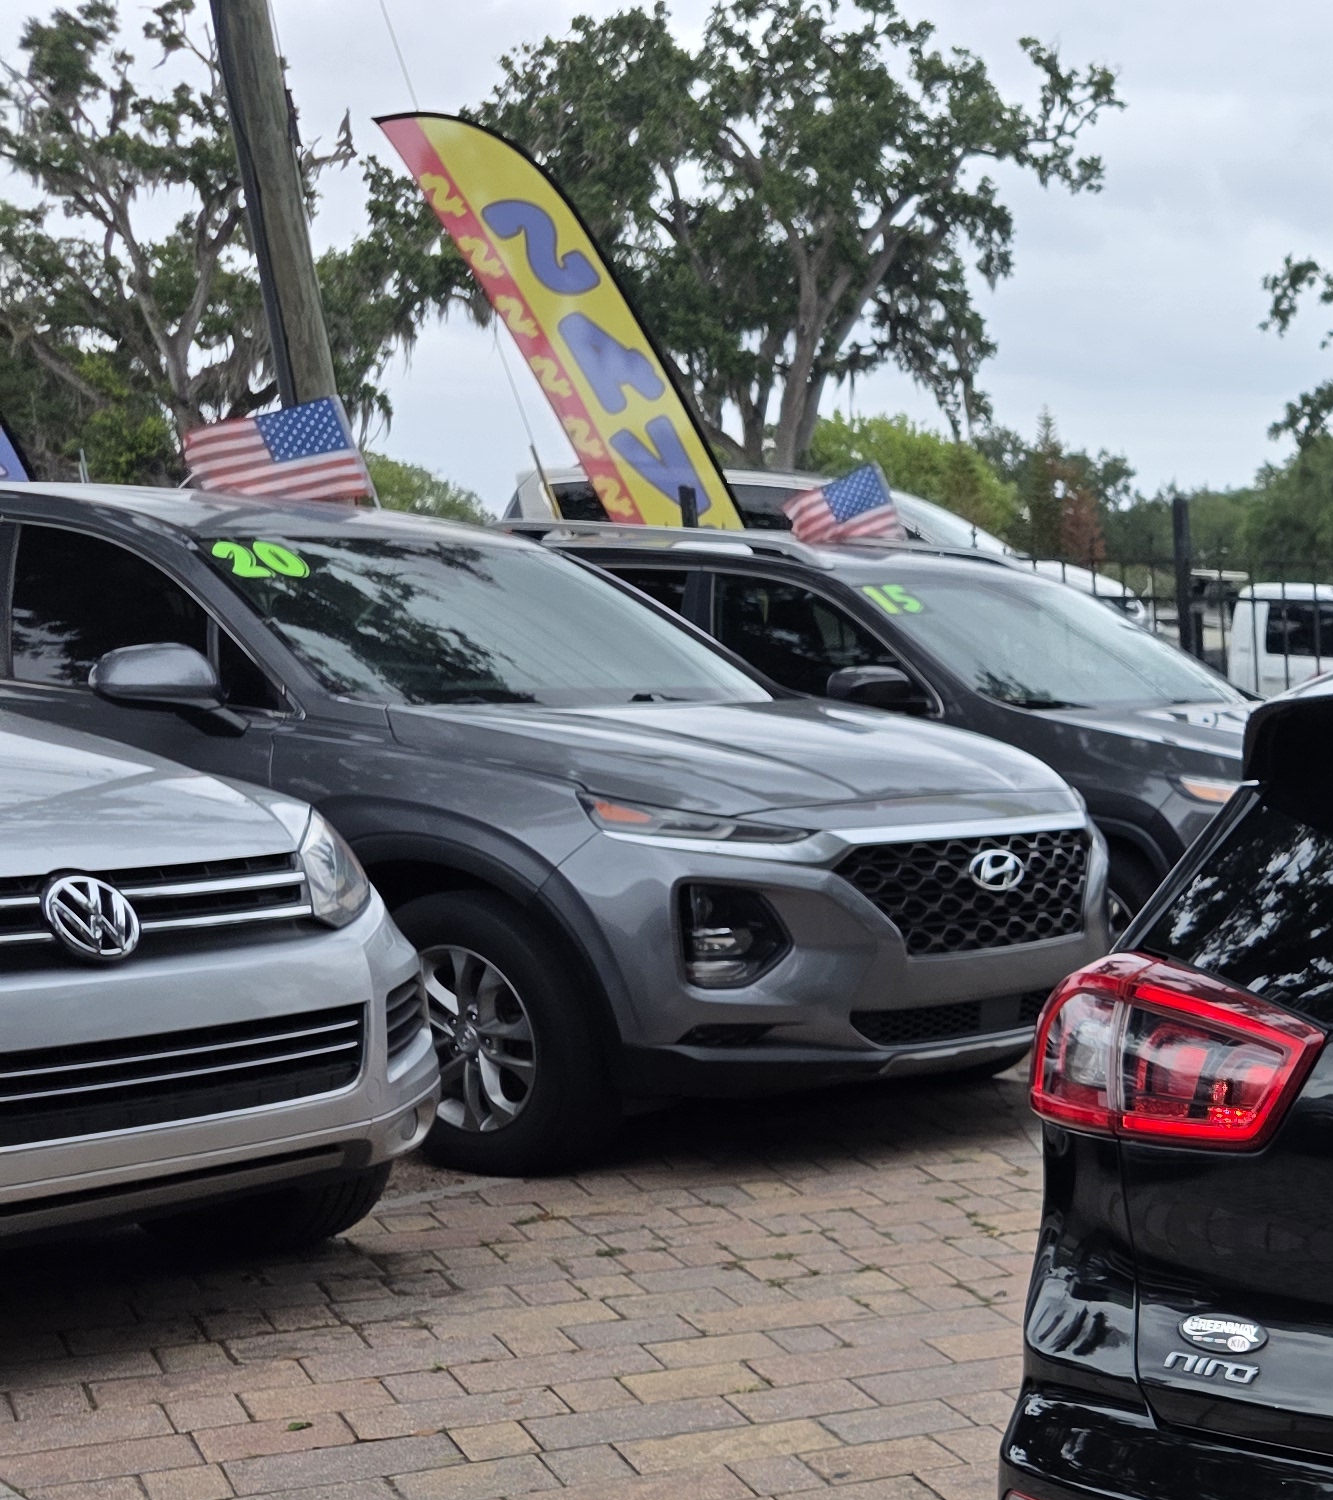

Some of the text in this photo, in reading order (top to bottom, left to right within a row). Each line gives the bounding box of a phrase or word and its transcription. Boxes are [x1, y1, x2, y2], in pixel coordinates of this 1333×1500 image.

[211, 541, 310, 579] 20
[862, 584, 925, 615] 15
[1183, 1316, 1259, 1342] GREENWAY
